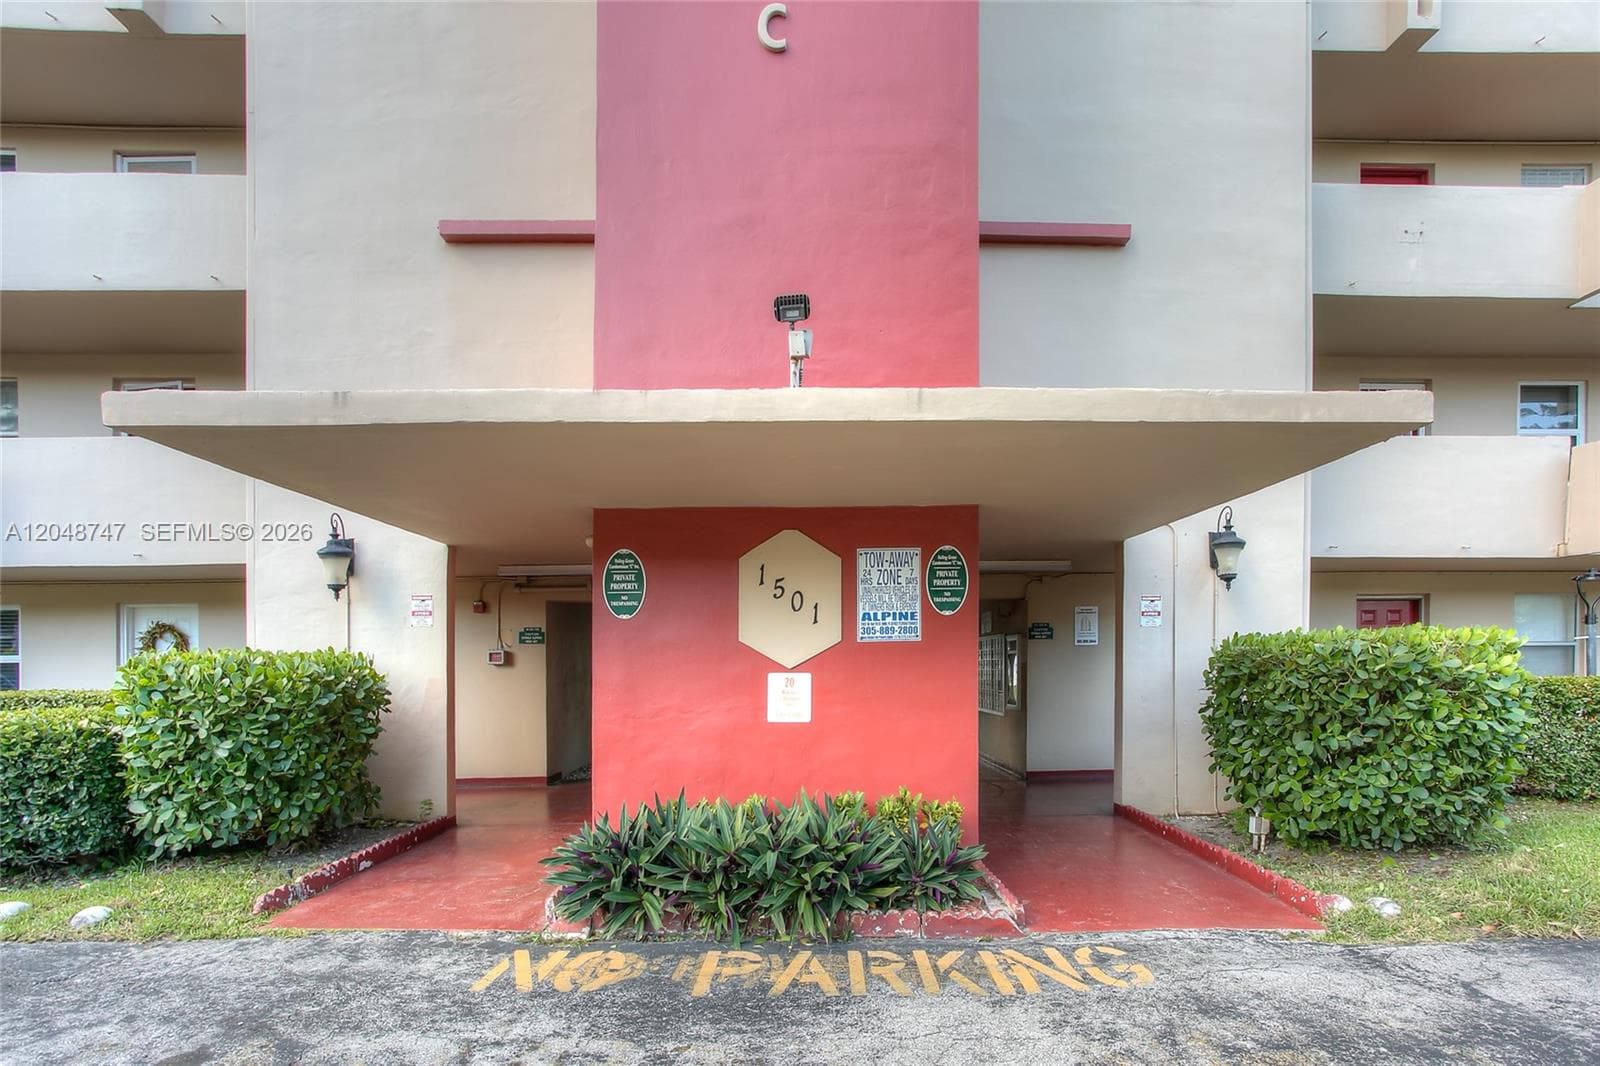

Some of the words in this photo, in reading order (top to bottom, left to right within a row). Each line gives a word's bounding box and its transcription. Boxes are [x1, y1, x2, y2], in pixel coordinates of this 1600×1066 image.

[757, 2, 787, 51] C
[864, 551, 915, 568] TOW-AWAY
[863, 569, 871, 577] 24
[876, 569, 902, 585] ZONE
[909, 569, 915, 577] 7
[860, 577, 873, 585] HRS
[905, 577, 918, 585] DAYS
[758, 563, 819, 625] 1501
[861, 611, 918, 621] ALPINE
[860, 626, 919, 635] 305-889-2800
[690, 946, 1155, 998] PARKING
